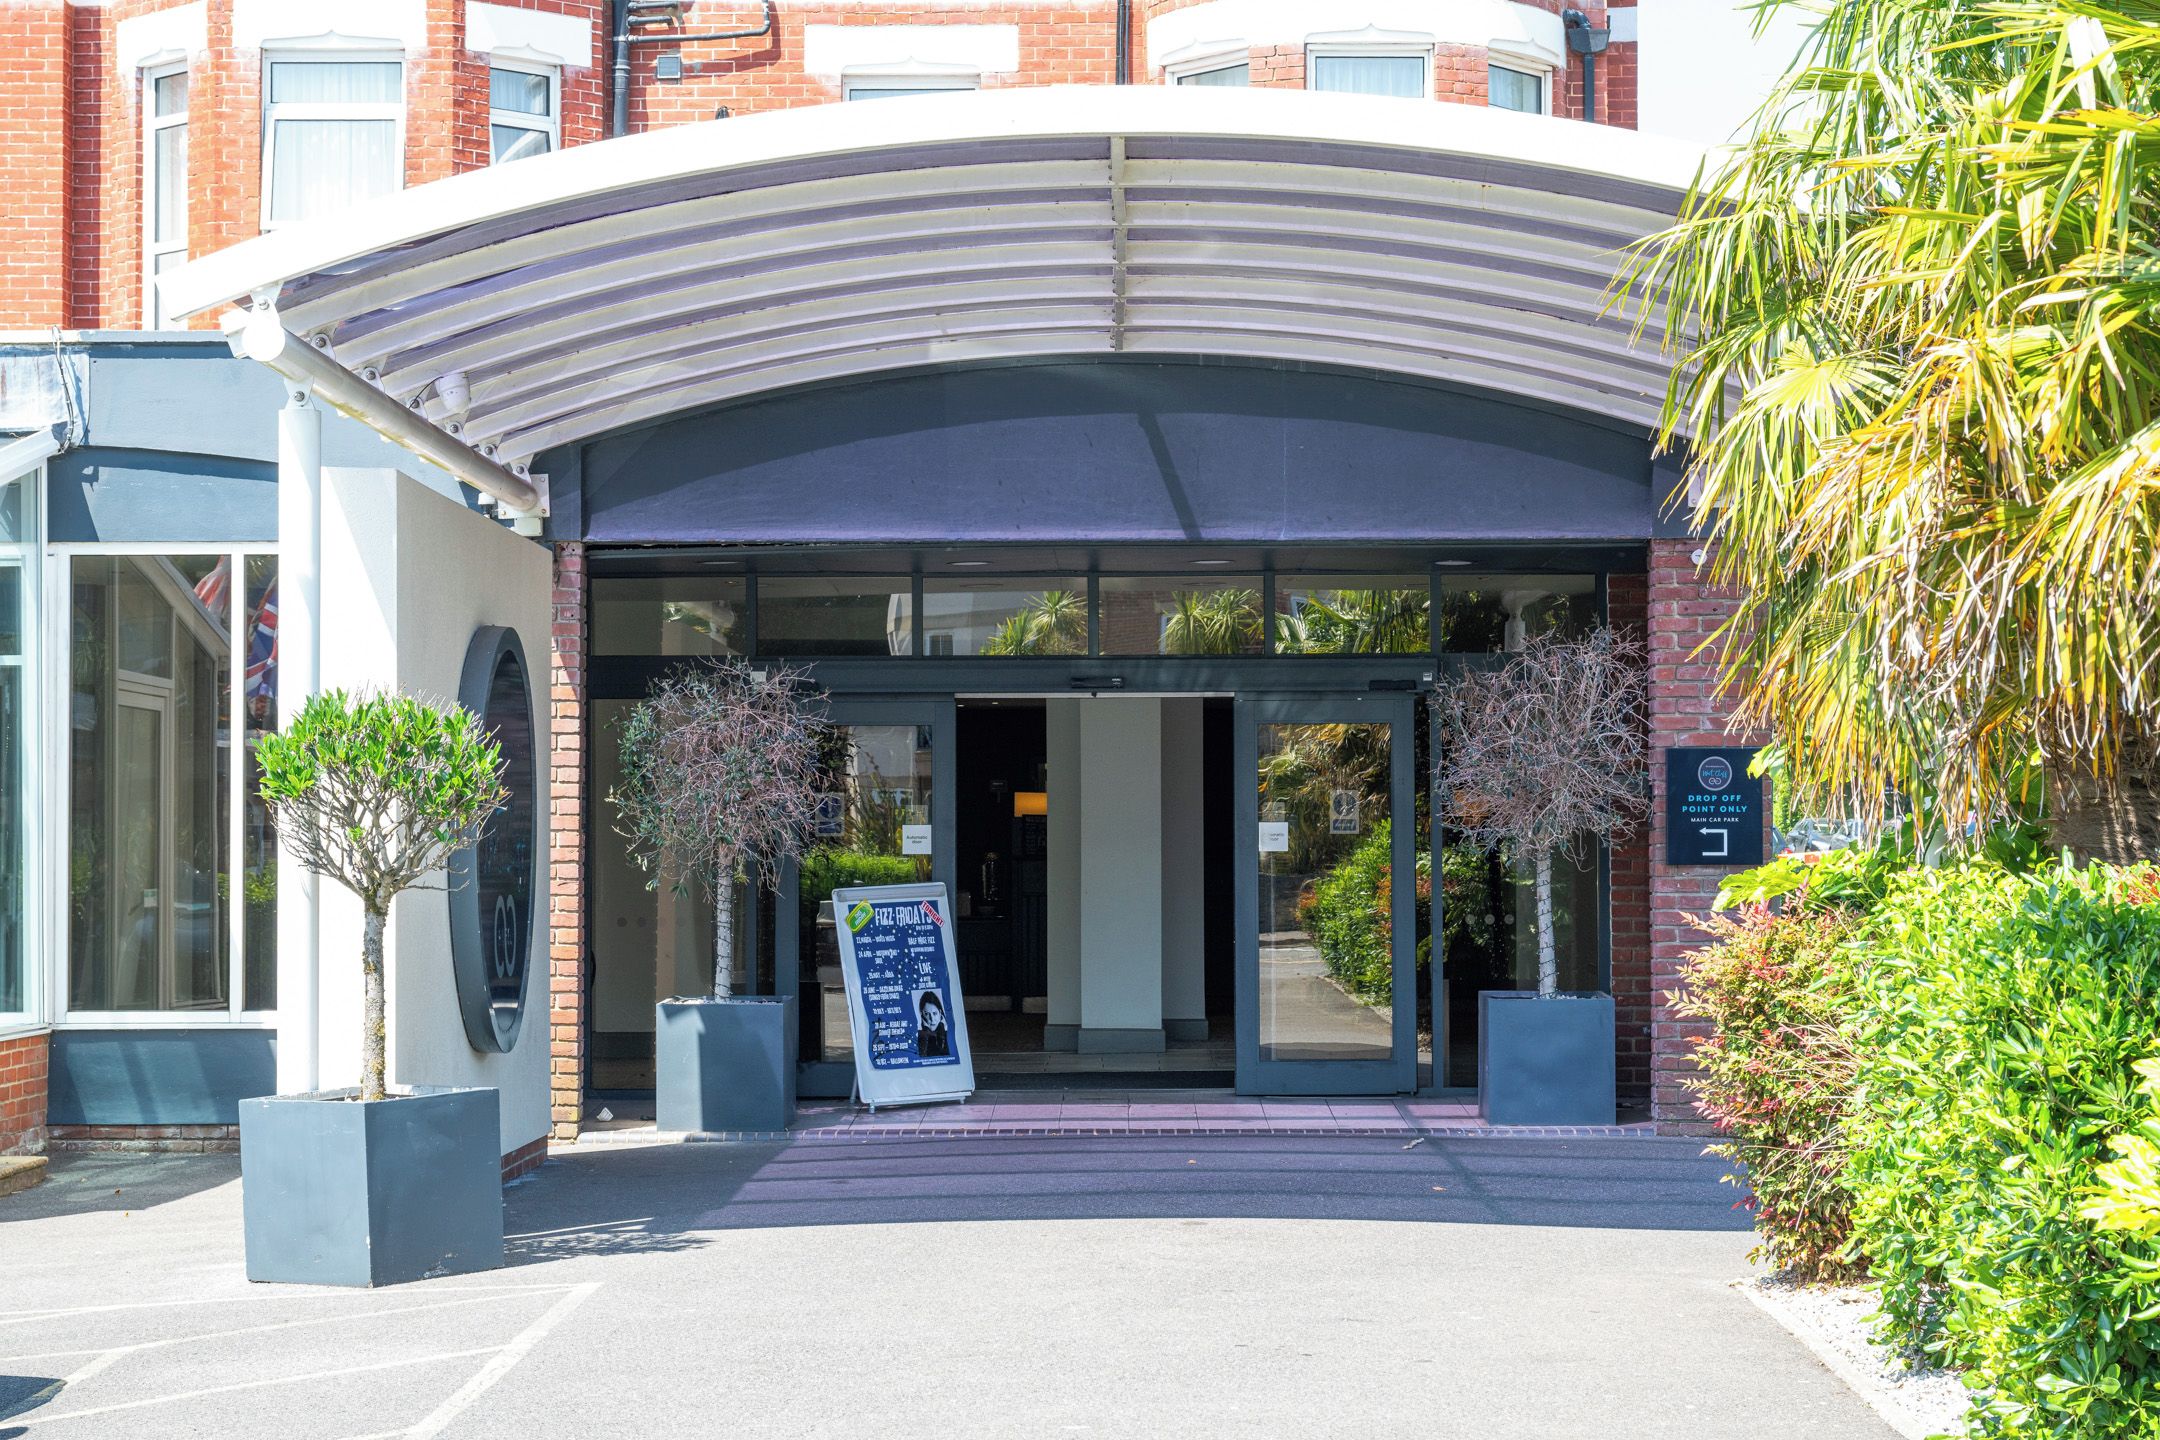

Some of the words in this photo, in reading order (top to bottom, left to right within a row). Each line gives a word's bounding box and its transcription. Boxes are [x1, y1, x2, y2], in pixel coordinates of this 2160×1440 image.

[1682, 805, 1715, 813] POINT
[1719, 805, 1748, 813] ONLY
[874, 907, 895, 926] FIZZ
[922, 901, 943, 926] TONIGHT
[918, 962, 933, 974] LIVE
